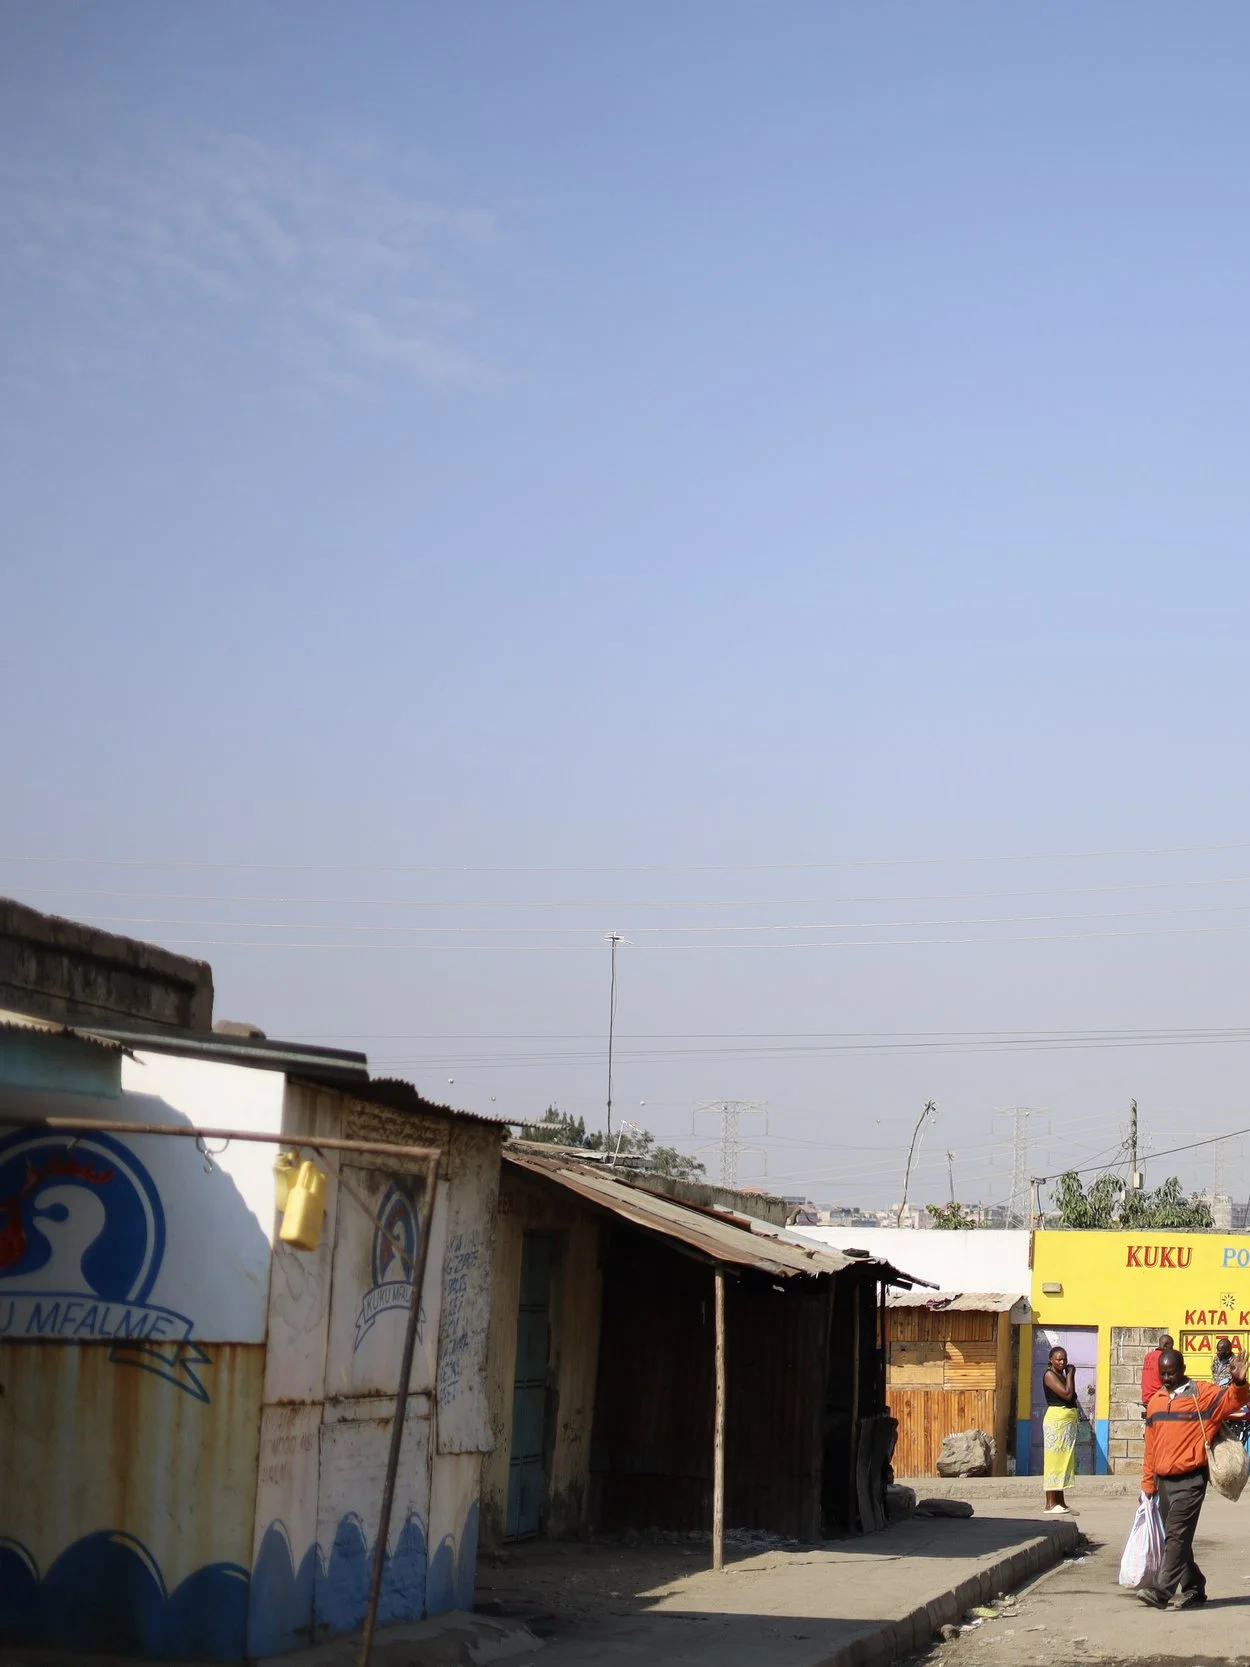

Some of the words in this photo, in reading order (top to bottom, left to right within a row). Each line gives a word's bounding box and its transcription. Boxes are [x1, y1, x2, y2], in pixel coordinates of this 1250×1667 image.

[1126, 1245, 1193, 1269] KUKU
[366, 1286, 391, 1314] KUKU
[1184, 1309, 1228, 1326] KATA
